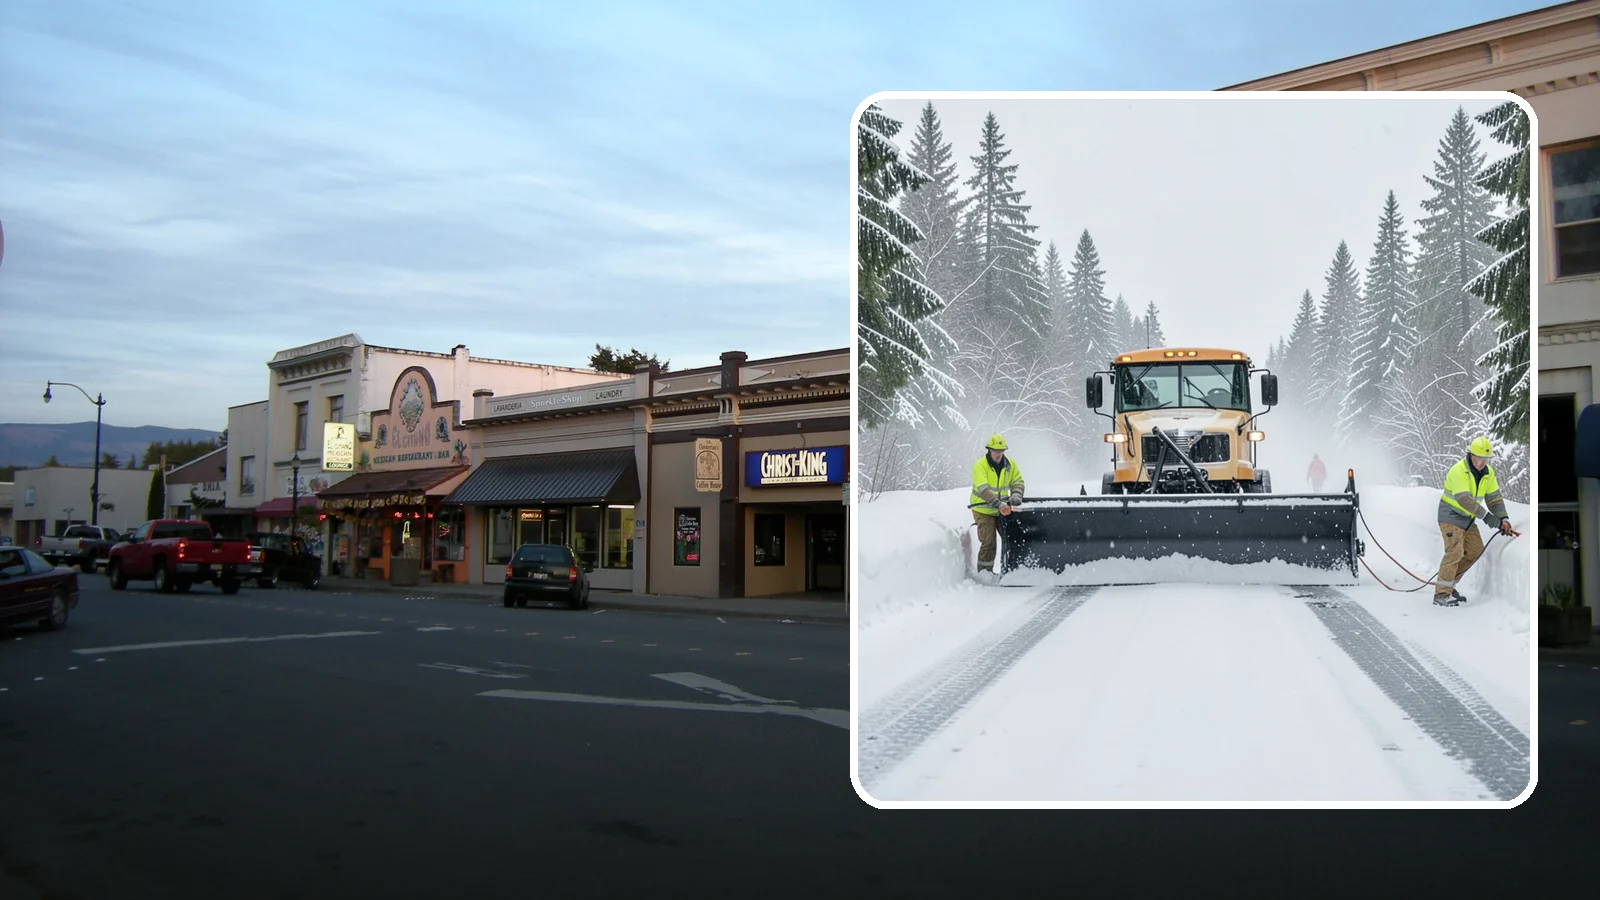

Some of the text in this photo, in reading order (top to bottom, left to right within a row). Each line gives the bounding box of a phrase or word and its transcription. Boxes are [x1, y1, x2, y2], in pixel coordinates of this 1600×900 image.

[530, 394, 583, 409] Sparkle Shop
[595, 389, 624, 400] LAUNDRY
[493, 402, 522, 413] LAVANDERIA
[374, 454, 396, 464] MEXICAN
[397, 451, 433, 463] RESTAURANT
[438, 450, 450, 460] BAR
[760, 450, 827, 478] CHRIST KING
